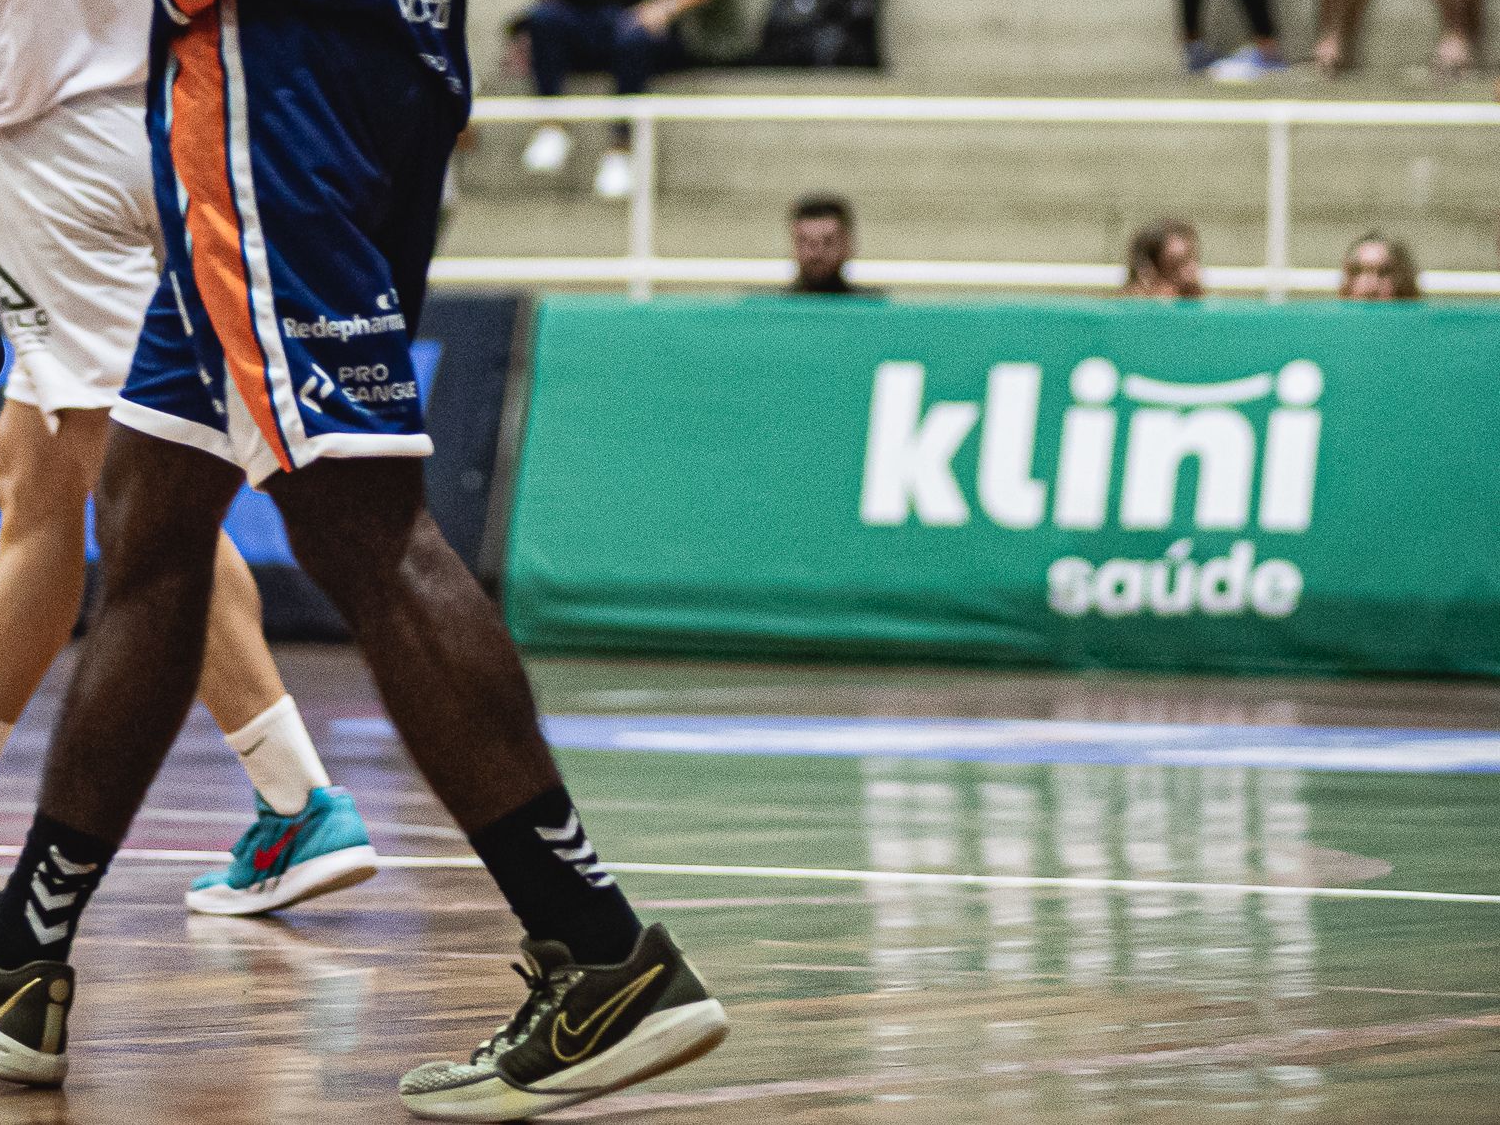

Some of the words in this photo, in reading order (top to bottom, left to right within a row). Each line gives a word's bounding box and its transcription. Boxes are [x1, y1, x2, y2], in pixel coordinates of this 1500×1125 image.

[338, 363, 389, 383] PRO
[858, 356, 1325, 533] klini
[1047, 539, 1304, 617] saúde
